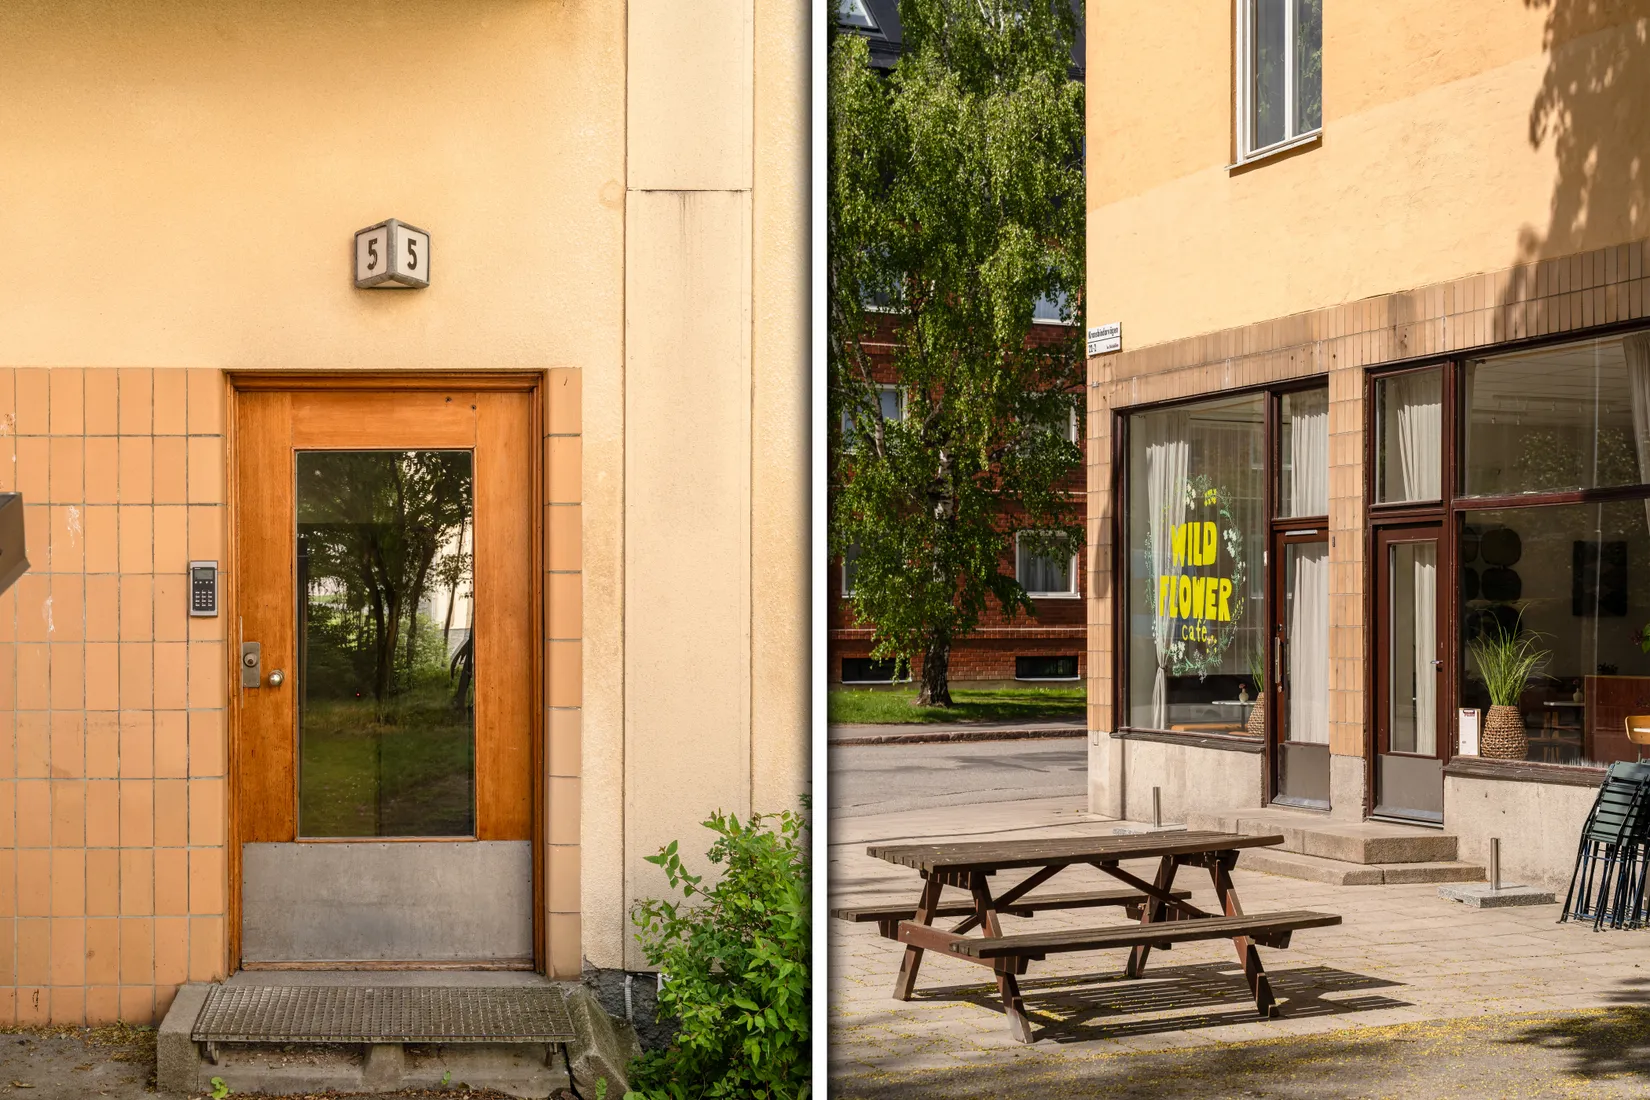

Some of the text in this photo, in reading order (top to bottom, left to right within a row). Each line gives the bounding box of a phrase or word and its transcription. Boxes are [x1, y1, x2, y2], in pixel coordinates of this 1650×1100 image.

[367, 238, 378, 270] 5
[407, 238, 417, 270] 5
[1171, 522, 1218, 567] WILD
[1159, 574, 1233, 622] FLOWER
[1181, 618, 1208, 642] café
